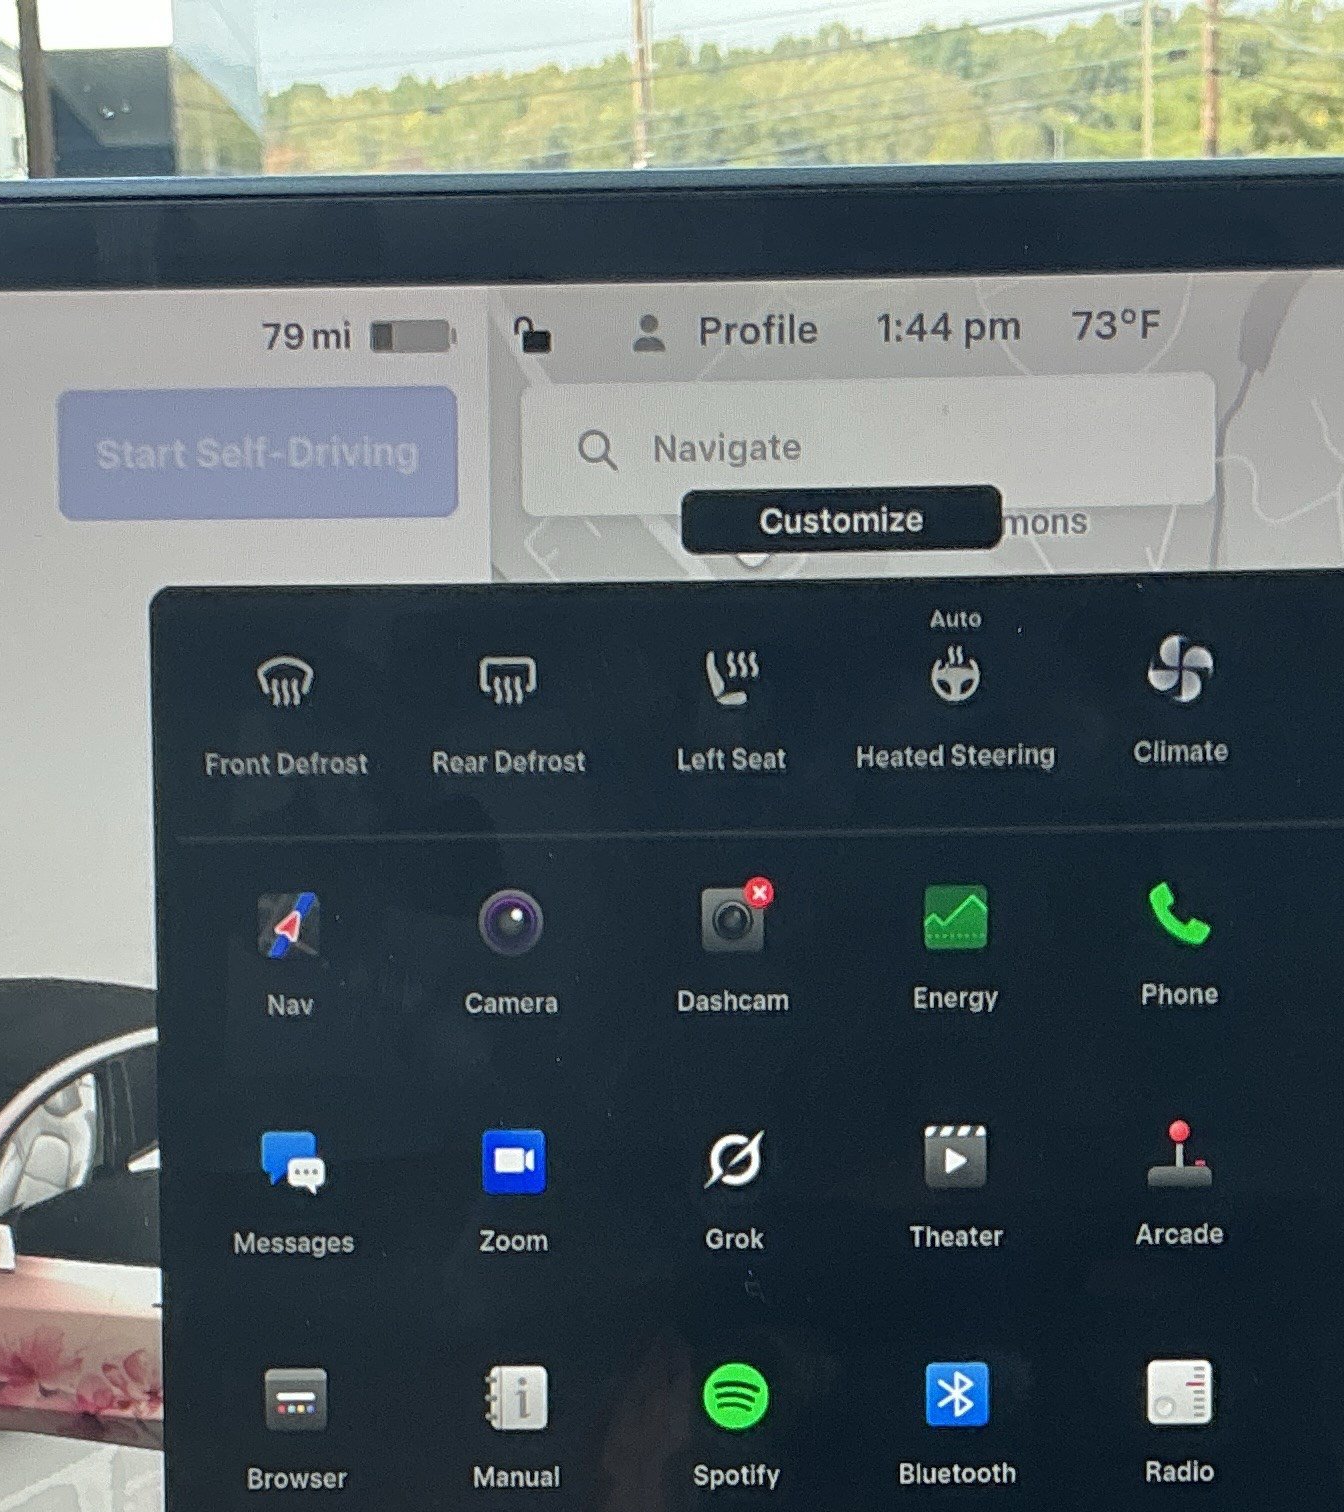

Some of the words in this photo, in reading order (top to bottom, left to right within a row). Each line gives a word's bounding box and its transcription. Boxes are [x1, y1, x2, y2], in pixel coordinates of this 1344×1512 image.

[262, 322, 305, 351] 79
[312, 320, 351, 350] mi
[700, 313, 818, 346] Profile
[877, 312, 952, 343] 1:44
[964, 317, 1021, 350] pm
[1071, 308, 1161, 341] 73°F
[96, 437, 186, 471] Start
[194, 431, 423, 478] Self-Driving
[653, 433, 802, 469] Navigate
[760, 507, 924, 535] Customize
[929, 609, 982, 629] Auto
[204, 752, 271, 776] Front
[277, 751, 368, 776] Defrost
[432, 750, 489, 774] Rear
[494, 749, 586, 774] Defrost
[677, 747, 726, 772] Left
[731, 747, 787, 771] Seat
[856, 744, 945, 769] Heated
[950, 742, 1055, 771] Steering
[1133, 739, 1229, 764] Climate
[267, 994, 314, 1016] Nav
[464, 992, 559, 1014] Camera
[677, 989, 789, 1012] Dashcam
[913, 986, 999, 1013] Energy
[1141, 982, 1219, 1006] Phone
[233, 1231, 355, 1259] Messages
[479, 1229, 549, 1252] Zoom
[705, 1227, 764, 1250] Grok
[909, 1225, 1004, 1248] Theater
[1135, 1222, 1224, 1245] Arcade
[247, 1467, 348, 1490] Browser
[473, 1465, 560, 1488] Manual
[693, 1463, 781, 1491] Spotify
[899, 1461, 1017, 1485] Bluetooth
[1145, 1459, 1215, 1483] Radio
